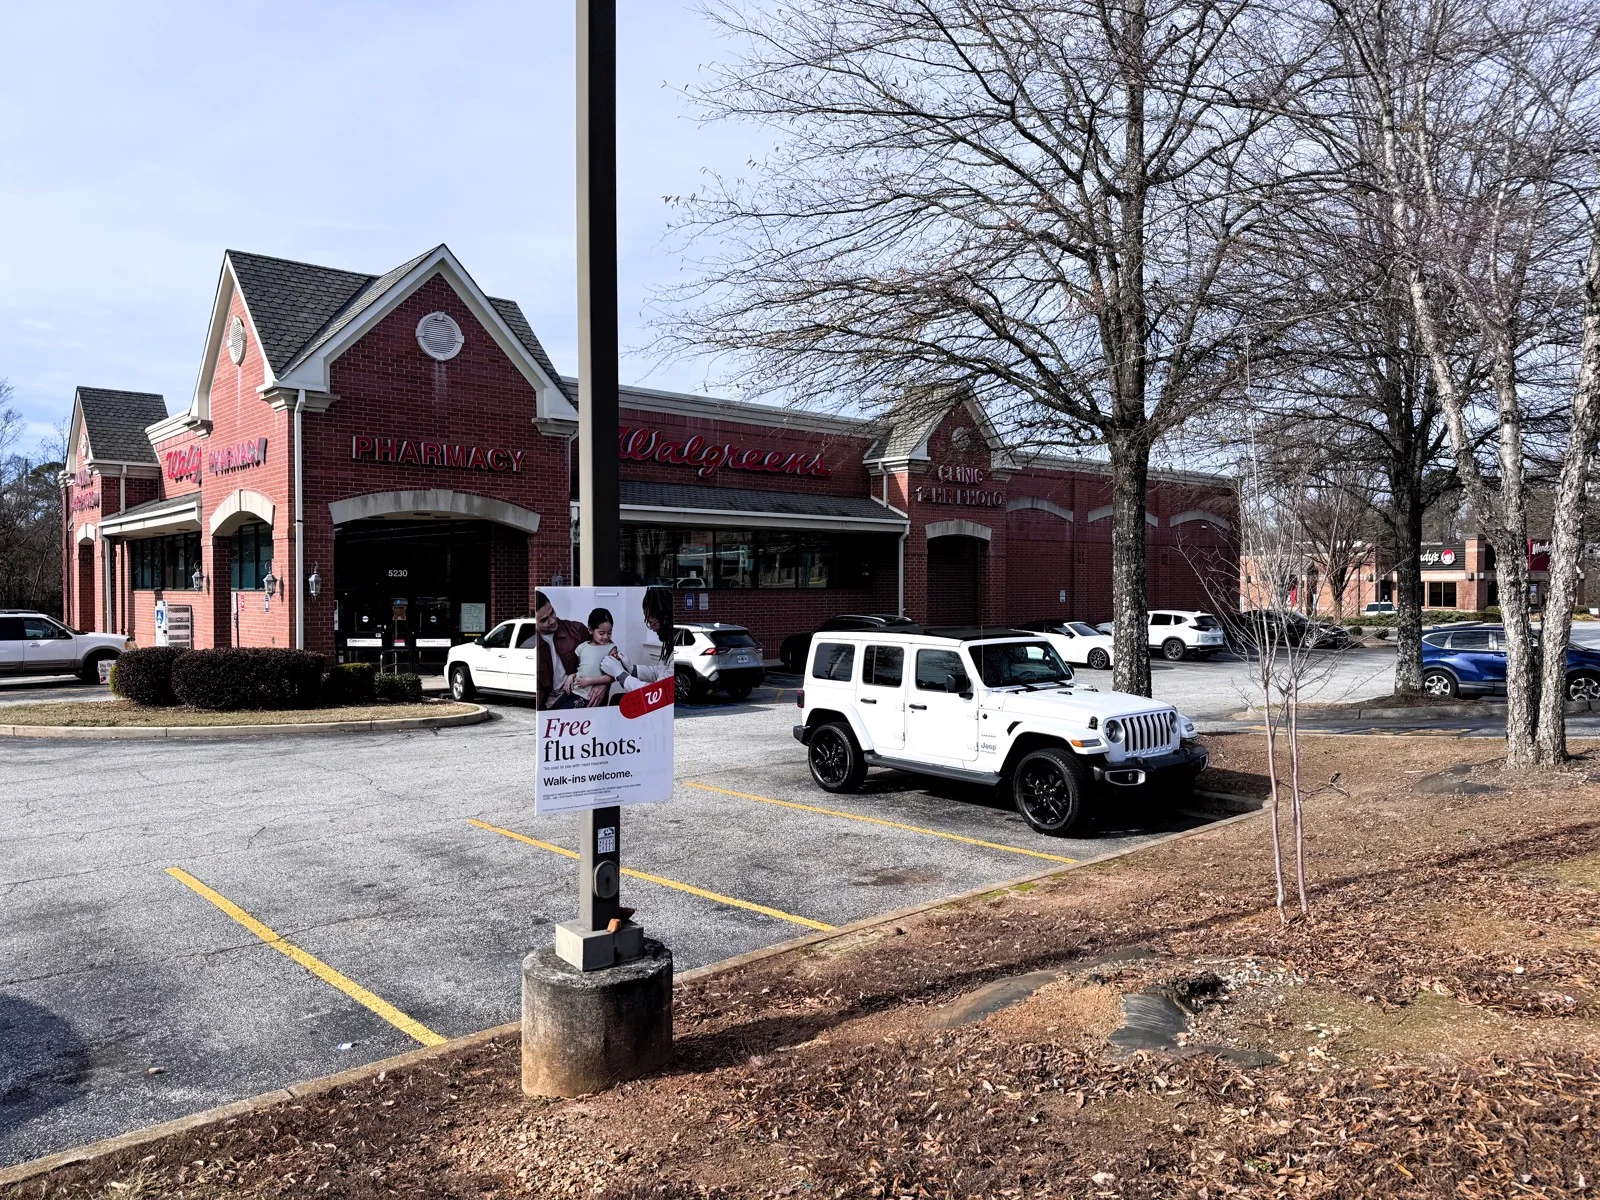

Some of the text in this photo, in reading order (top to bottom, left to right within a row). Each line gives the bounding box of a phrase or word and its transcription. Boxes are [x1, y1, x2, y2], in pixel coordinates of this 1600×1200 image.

[352, 436, 526, 472] PHARMACY
[619, 426, 832, 478] Walgreens
[937, 464, 983, 485] CLINIC
[956, 489, 1004, 507] PHOTO
[388, 569, 408, 577] 5230
[543, 718, 591, 739] Free
[543, 739, 575, 763] flu
[543, 770, 633, 787] Walk-ins welcome.
